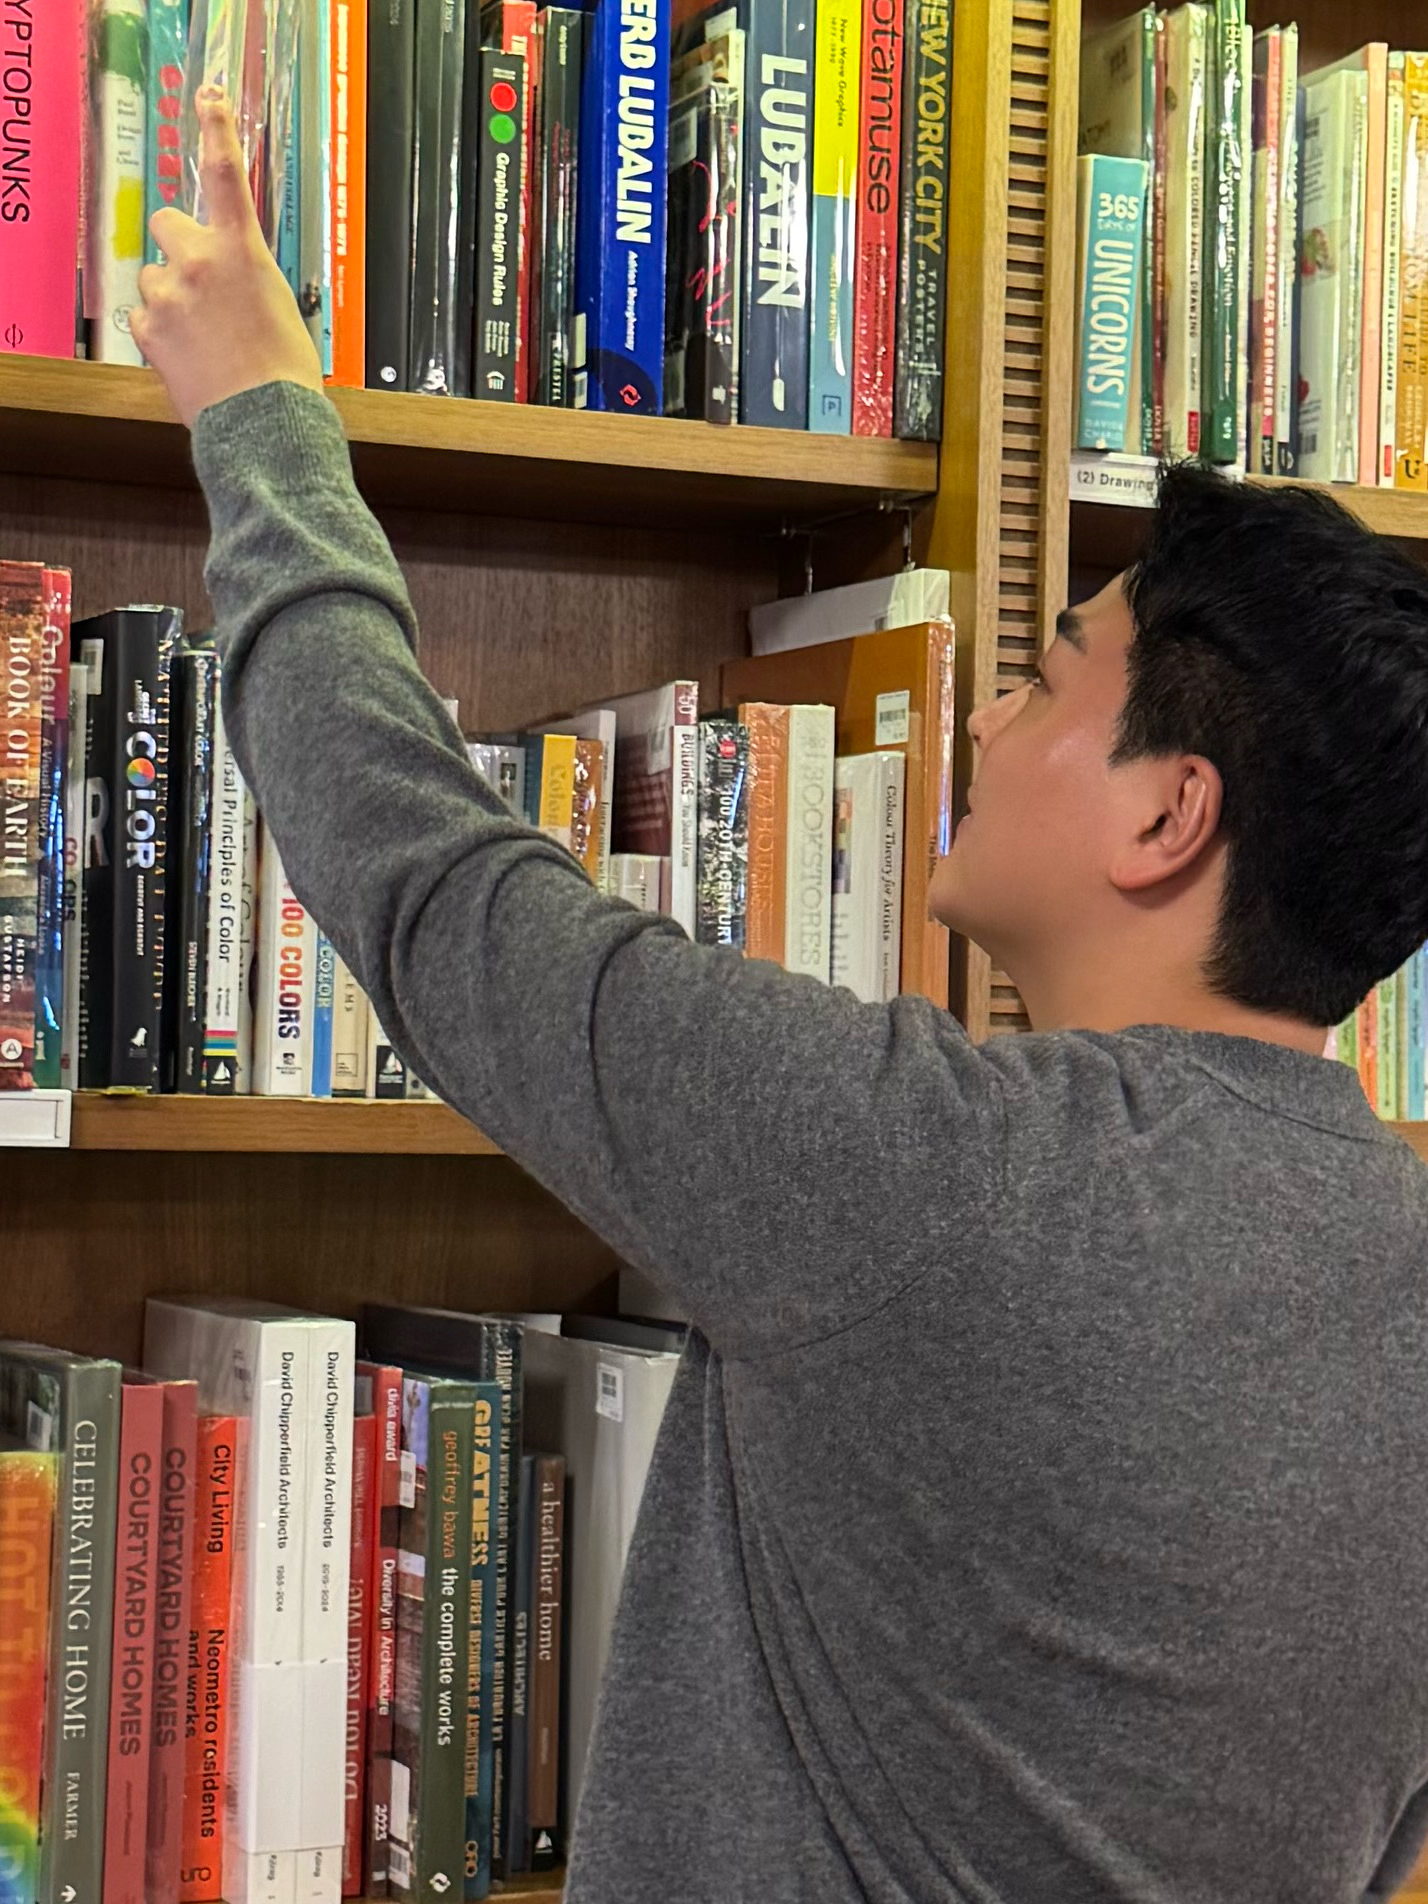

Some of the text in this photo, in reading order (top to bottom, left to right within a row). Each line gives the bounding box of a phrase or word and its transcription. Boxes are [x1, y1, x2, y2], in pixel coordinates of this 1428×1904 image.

[615, 74, 656, 244] LUBALIN
[757, 54, 808, 309] LUBALIN
[917, 67, 946, 169] YORK
[914, 173, 942, 254] CITY
[1099, 193, 1139, 219] 365
[1086, 239, 1134, 398] UNICORNS
[1077, 471, 1154, 491] (2) Drawing
[206, 1444, 232, 1554] City Living
[61, 1420, 97, 1840] CELEBRATING HOME FARMER
[119, 1452, 152, 1757] COURTYARD HOMES
[435, 1430, 460, 1746] geoffrey bawa the complete works
